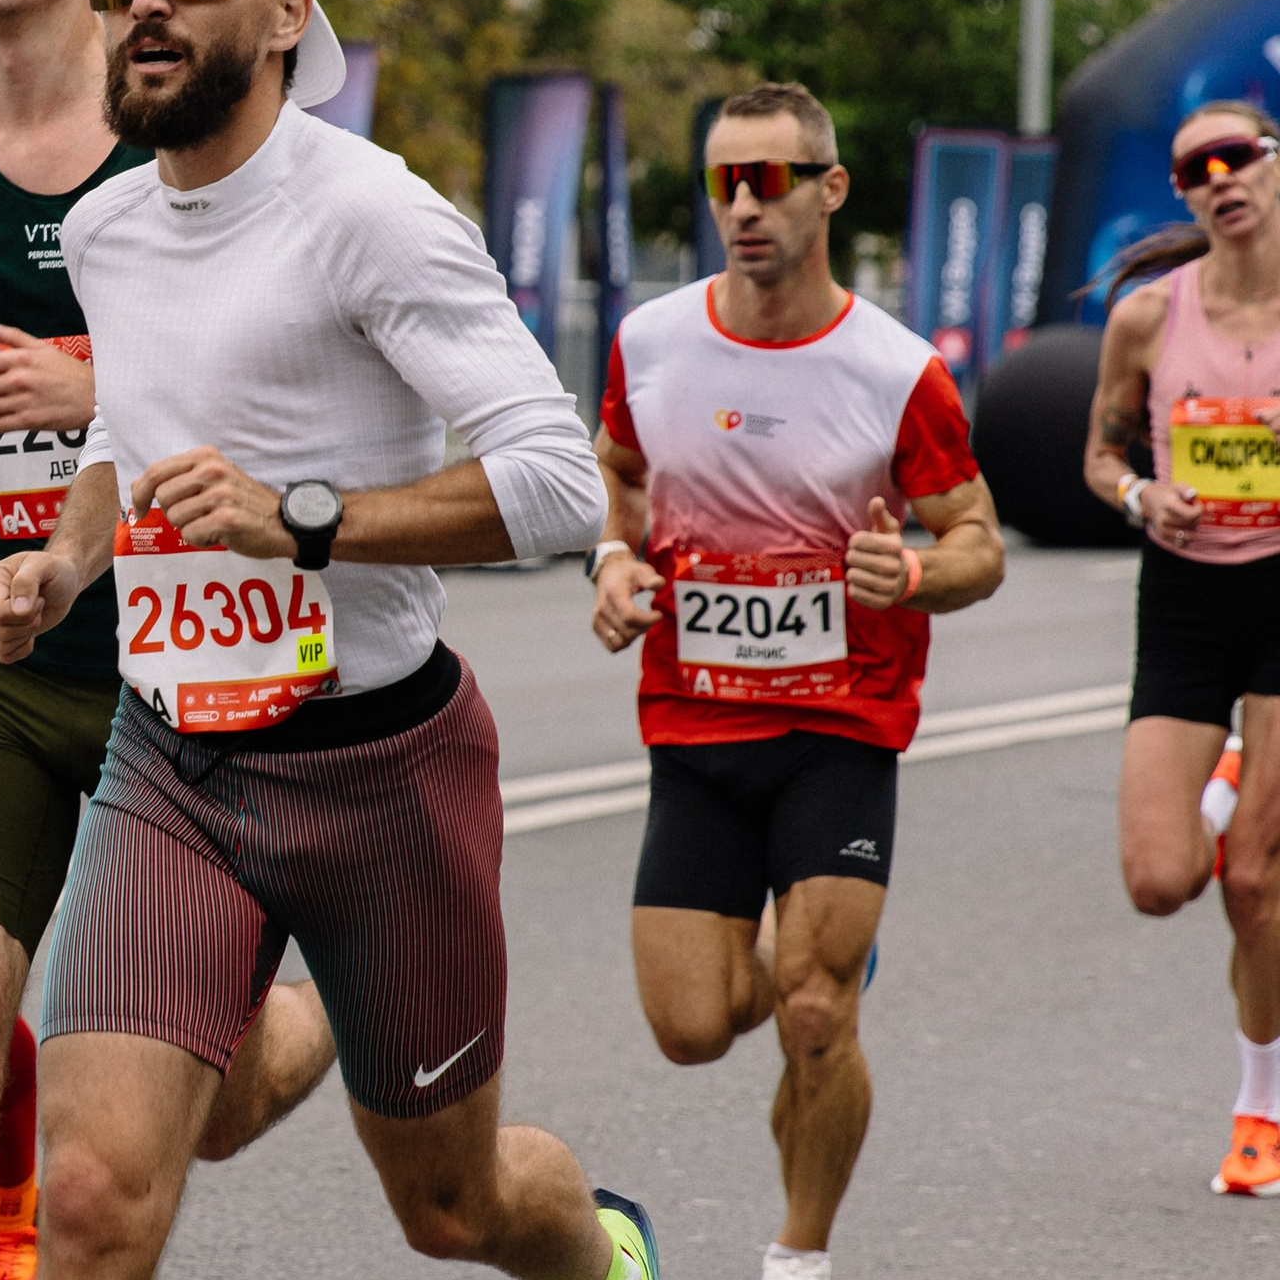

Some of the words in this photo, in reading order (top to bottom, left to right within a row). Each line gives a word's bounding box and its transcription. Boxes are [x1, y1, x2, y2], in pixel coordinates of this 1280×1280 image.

[774, 572, 797, 587] 10
[128, 574, 327, 655] 26304
[683, 590, 832, 639] 22041
[299, 642, 324, 665] VIP
